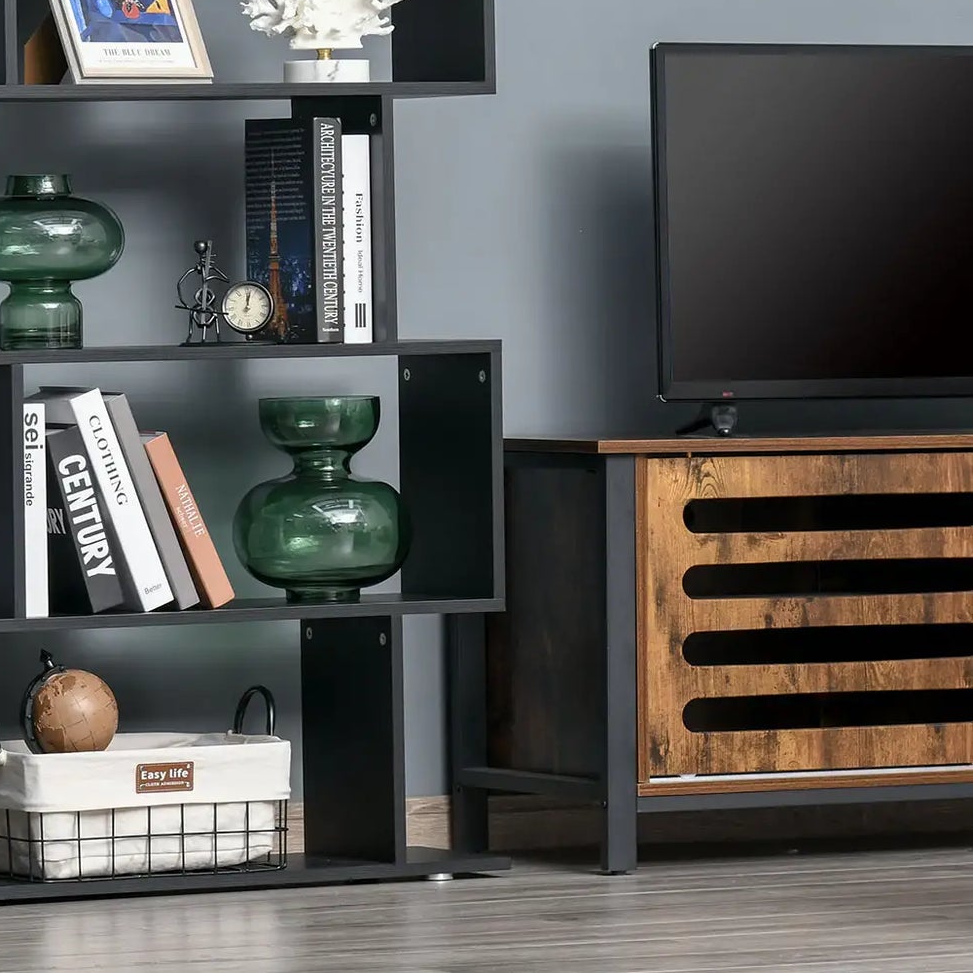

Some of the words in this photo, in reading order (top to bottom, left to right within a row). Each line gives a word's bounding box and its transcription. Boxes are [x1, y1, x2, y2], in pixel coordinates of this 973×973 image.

[103, 47, 120, 56] THE
[121, 48, 141, 56] BLUE
[144, 48, 172, 57] DREAM
[322, 195, 336, 206] IN
[322, 206, 336, 226] THE
[355, 193, 365, 243] Fashion
[322, 226, 338, 280] TWENTIETH
[323, 281, 339, 325] CENTURY
[24, 412, 44, 450] sei
[89, 415, 128, 506] CLOTHING
[58, 454, 116, 577] CENTURY
[176, 484, 205, 537] NATHALIE
[141, 770, 166, 781] Easy
[169, 768, 189, 778] life
